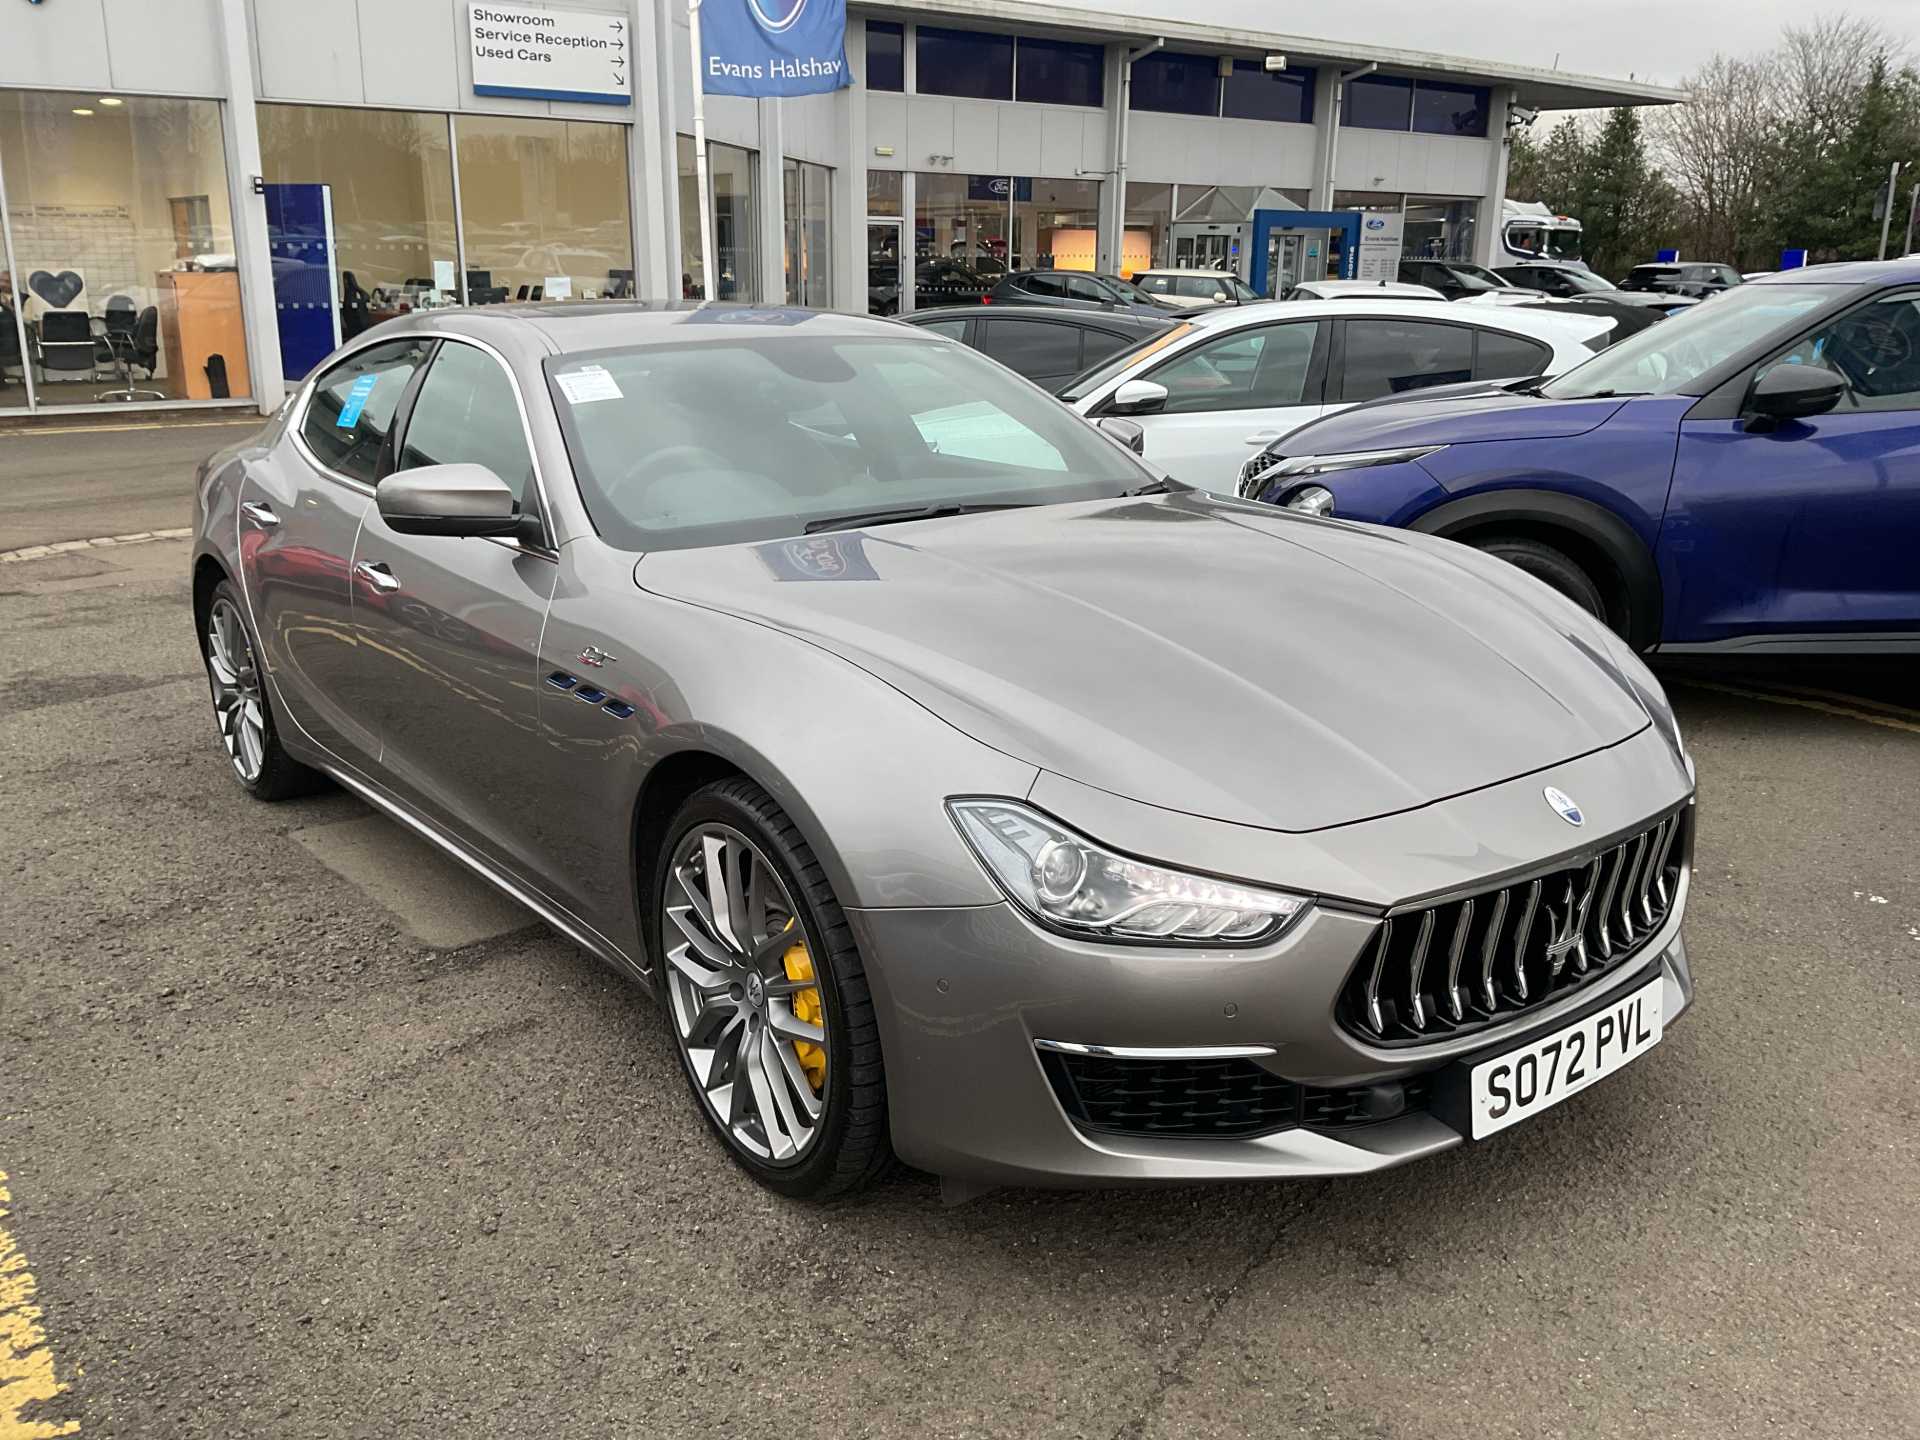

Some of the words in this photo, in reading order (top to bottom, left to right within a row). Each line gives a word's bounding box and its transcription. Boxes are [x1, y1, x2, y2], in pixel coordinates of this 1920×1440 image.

[474, 9, 555, 27] Showroom
[475, 27, 531, 43] Service
[535, 32, 607, 49] Reception
[475, 46, 514, 60] Used
[517, 49, 552, 62] Cars
[709, 56, 763, 79] Evans
[1488, 1030, 1585, 1119] SO72
[1596, 997, 1650, 1070] PVL
